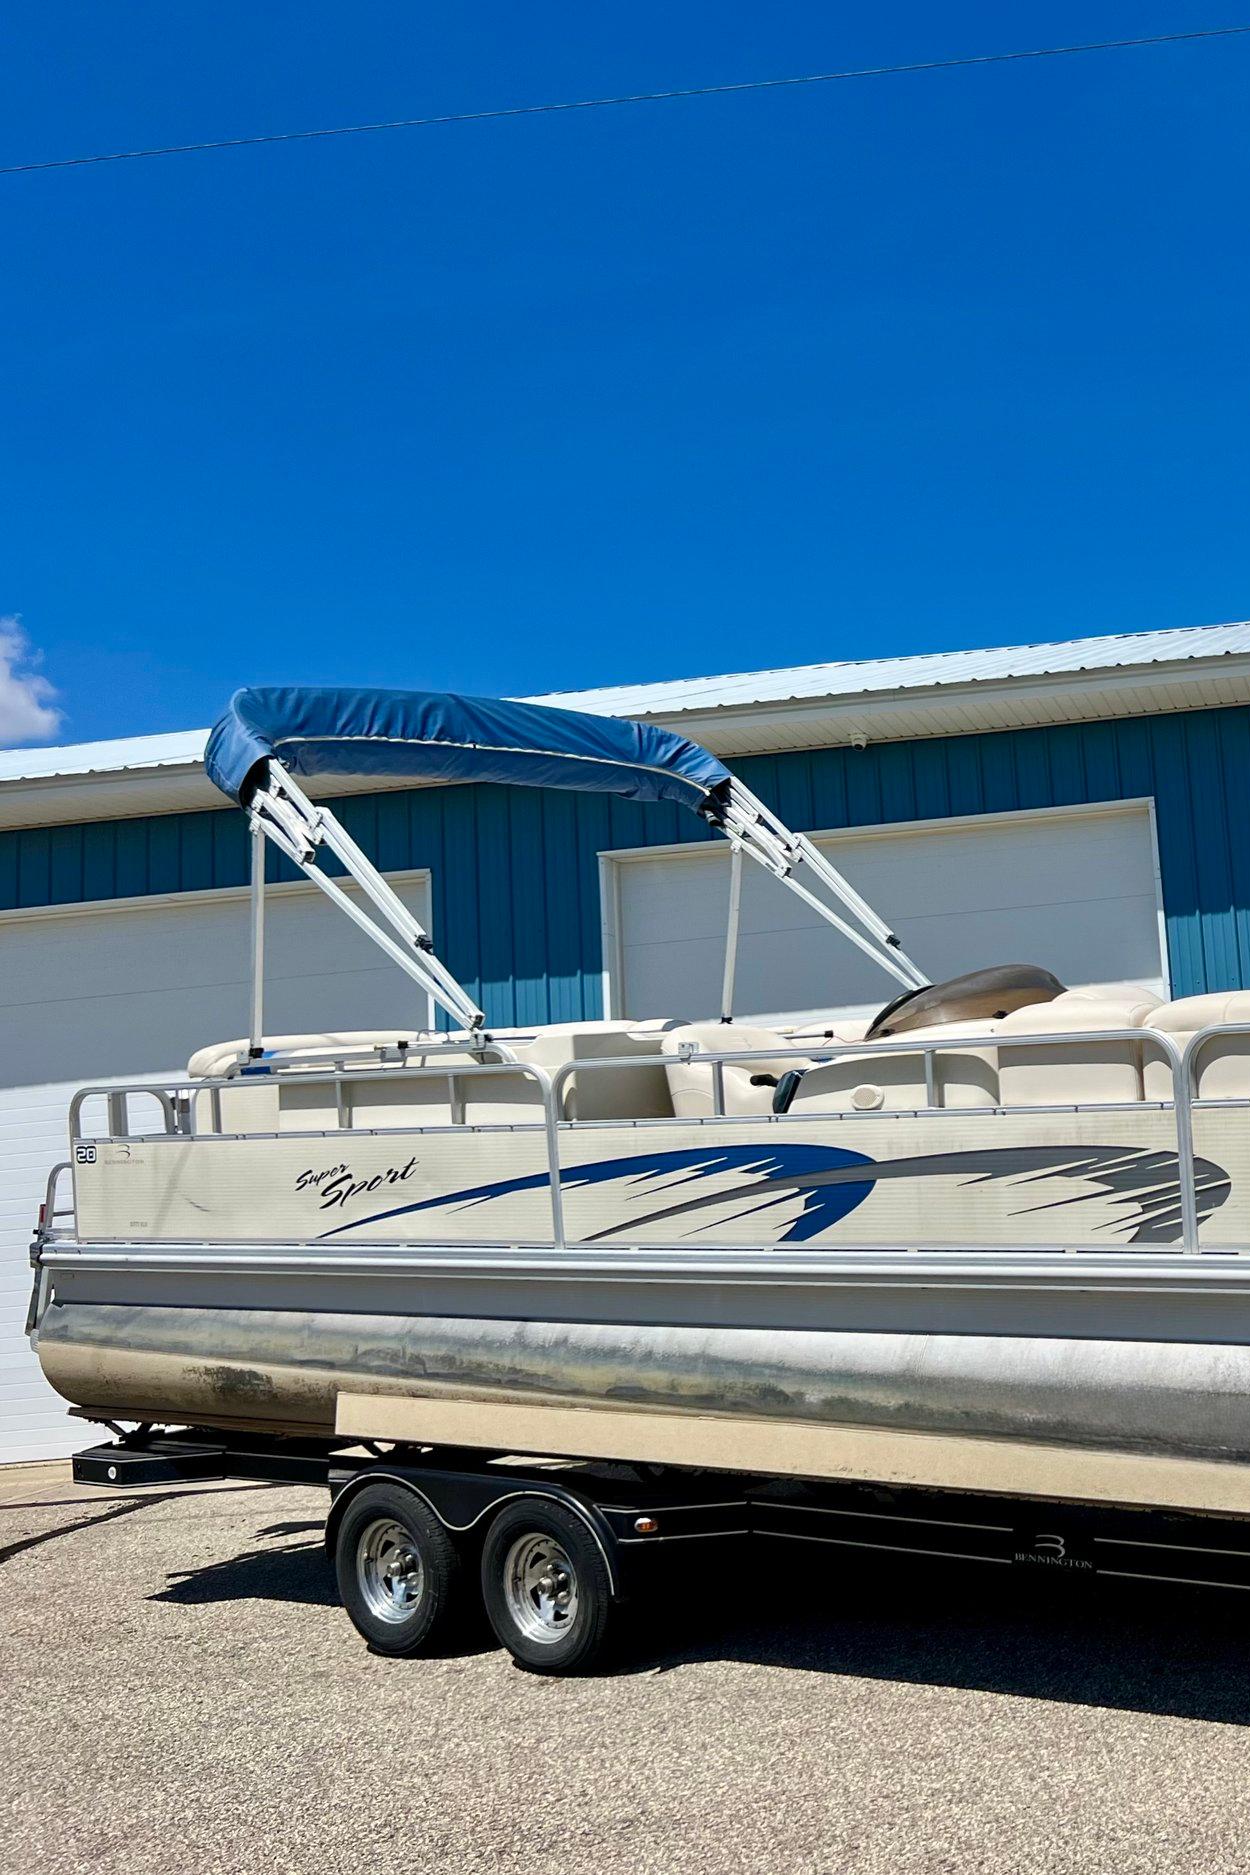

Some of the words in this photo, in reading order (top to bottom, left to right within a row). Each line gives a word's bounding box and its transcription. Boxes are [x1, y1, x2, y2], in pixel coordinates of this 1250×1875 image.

[76, 1146, 96, 1163] 20
[295, 1163, 350, 1191] Super
[319, 1156, 419, 1210] Sport
[1015, 1552, 1092, 1568] BENNINGTON
